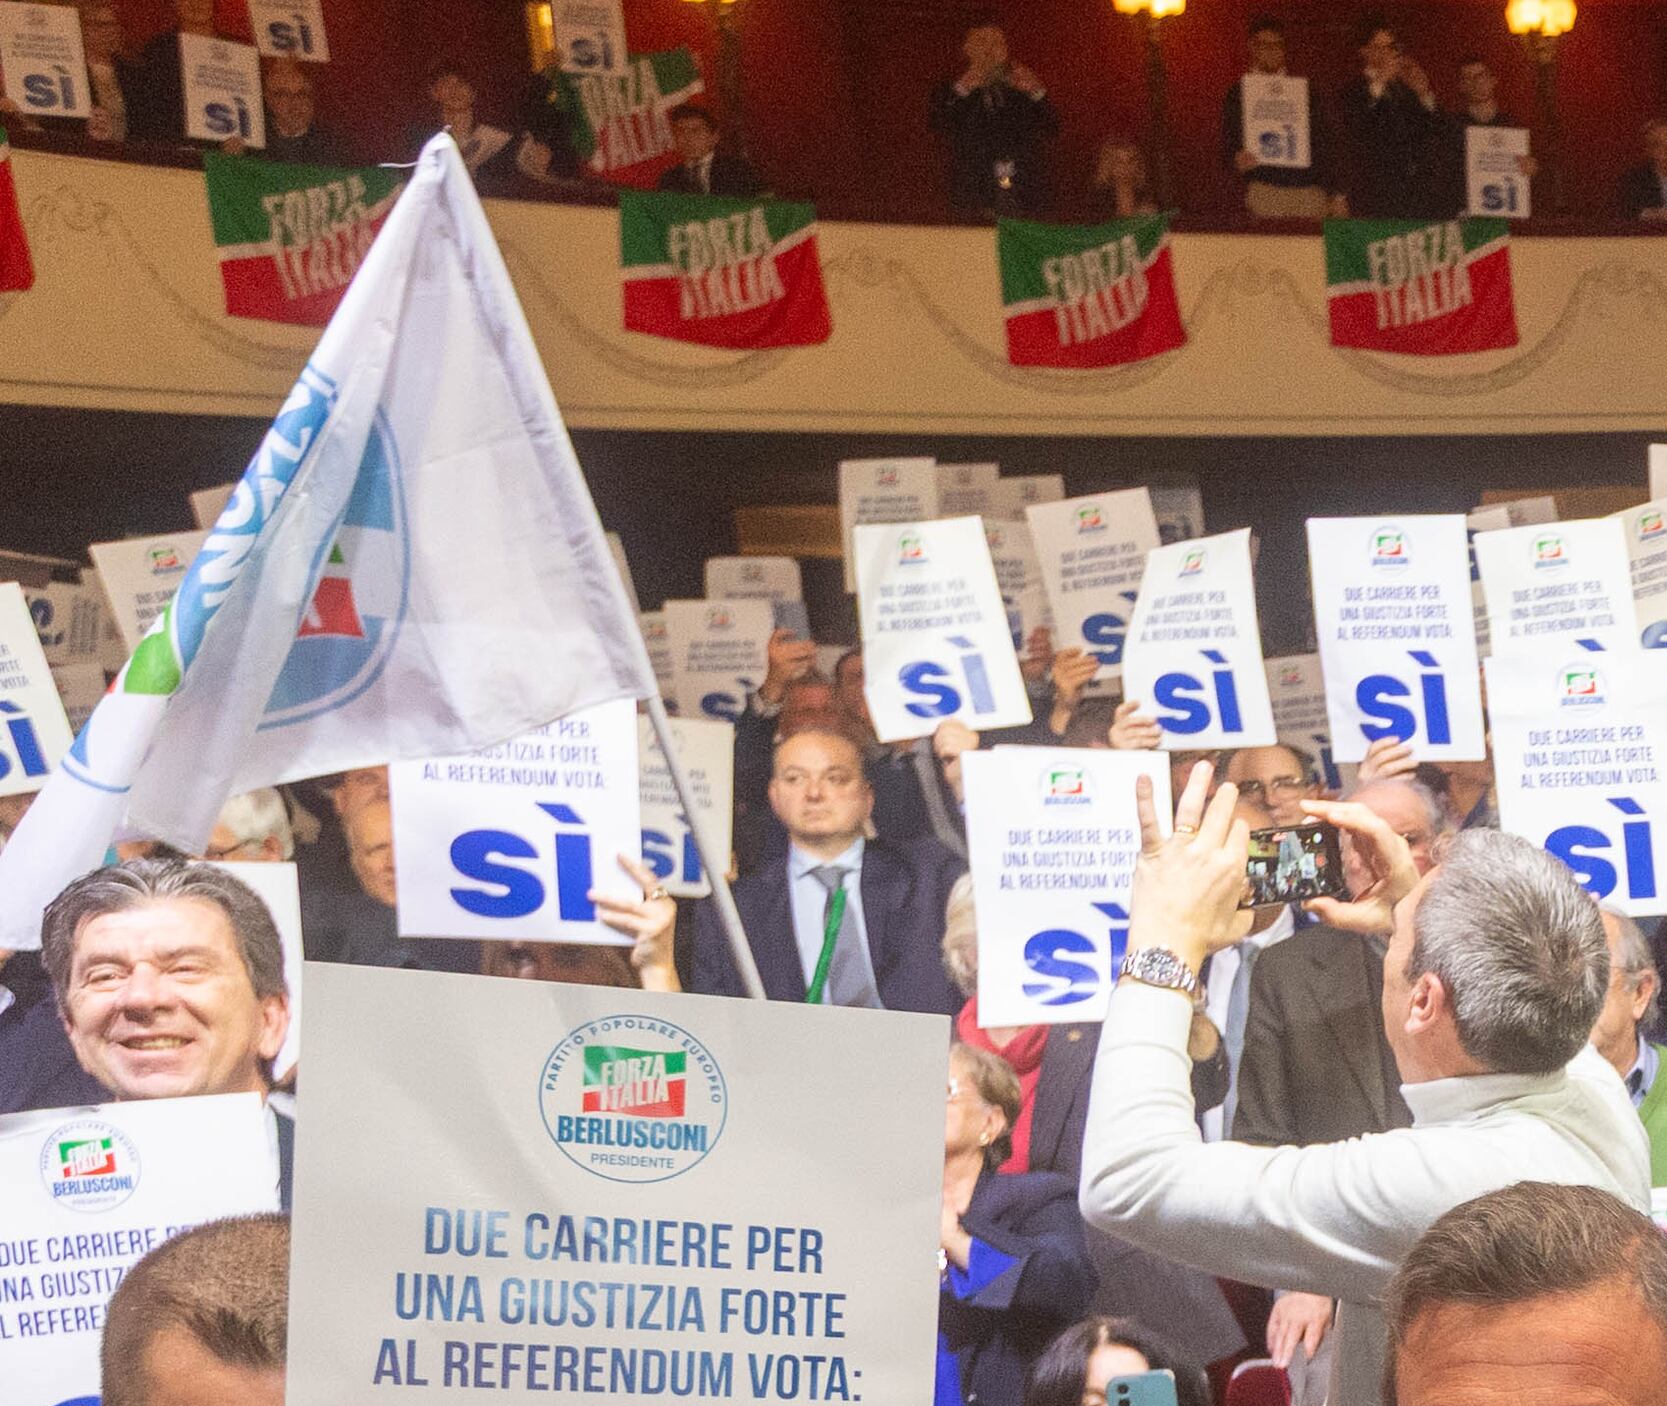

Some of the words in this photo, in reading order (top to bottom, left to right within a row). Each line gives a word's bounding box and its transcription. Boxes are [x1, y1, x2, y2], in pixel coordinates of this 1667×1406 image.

[669, 206, 773, 272] FORZA
[1042, 235, 1140, 300] FORZA
[1366, 222, 1462, 287] FORZA
[679, 258, 783, 318] ITALIA
[1055, 277, 1148, 345] ITALIA
[1378, 262, 1472, 328] ITALIA
[546, 1035, 585, 1091] PARTITO
[590, 1019, 678, 1039] POPOLARE
[681, 1038, 721, 1104] EUROPEO
[599, 1078, 670, 1110] ITALIA
[601, 1054, 666, 1086] FORZA
[557, 1115, 708, 1152] BERLUSCONI
[591, 1153, 674, 1169] PRESIDENTE
[425, 1208, 508, 1258] DUE
[525, 1213, 732, 1269] CARRIERE
[747, 1226, 822, 1273] PER
[396, 1273, 484, 1322] UNA
[500, 1278, 705, 1332] GIUSTIZIA
[720, 1288, 846, 1338] FORTE
[373, 1339, 428, 1386] AL
[444, 1341, 733, 1397] REFERENDUM
[748, 1354, 861, 1401] VOTA:
